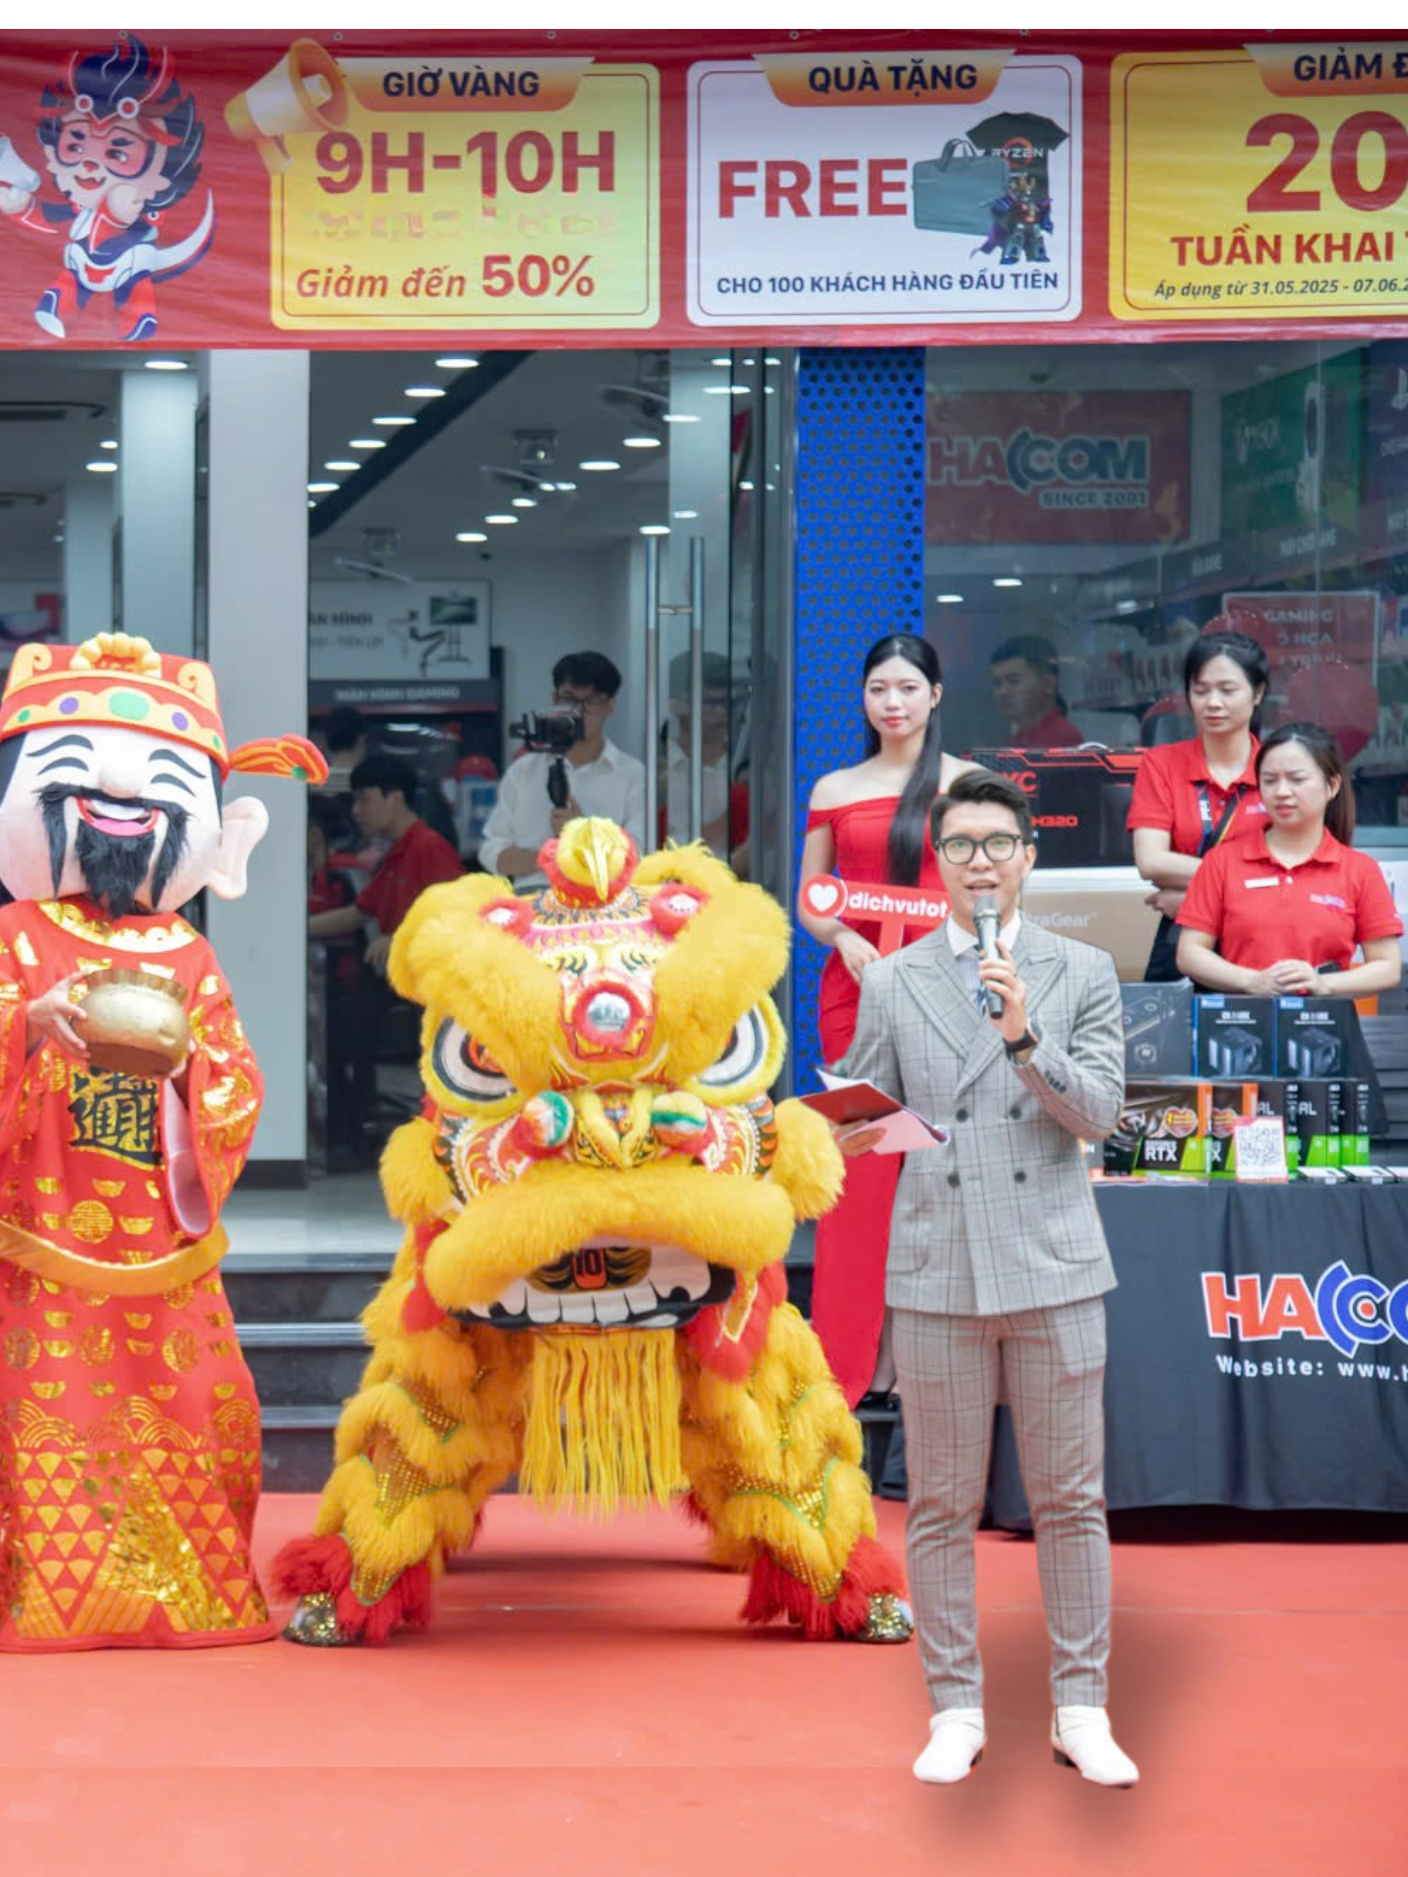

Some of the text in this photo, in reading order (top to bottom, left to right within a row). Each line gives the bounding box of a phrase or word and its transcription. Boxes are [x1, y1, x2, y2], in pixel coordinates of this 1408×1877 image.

[808, 58, 977, 97] QUÀ TẶNG
[1294, 46, 1382, 81] GIẢM
[382, 64, 540, 97] GIỜ VÀNG
[315, 130, 615, 196] 9H-10H
[992, 148, 1043, 158] RYZEN
[718, 158, 908, 219] FREE
[1170, 223, 1394, 267] TUẦN KHAI
[296, 254, 595, 298] Giảm đến 50%
[717, 277, 763, 293] CHO
[769, 276, 805, 292] 100
[810, 272, 886, 292] KHÁCH
[892, 271, 953, 291] HÀNG
[1011, 269, 1058, 289] TIÊN
[1155, 279, 1176, 300] Áp
[1181, 281, 1222, 300] dụng
[1227, 280, 1246, 296] từ
[1251, 280, 1339, 295] 31.05.2025
[1042, 489, 1147, 506] SINCE 2001
[848, 891, 949, 918] dichvutot
[1145, 1148, 1178, 1162] RTX
[1215, 1354, 1325, 1378] Website:
